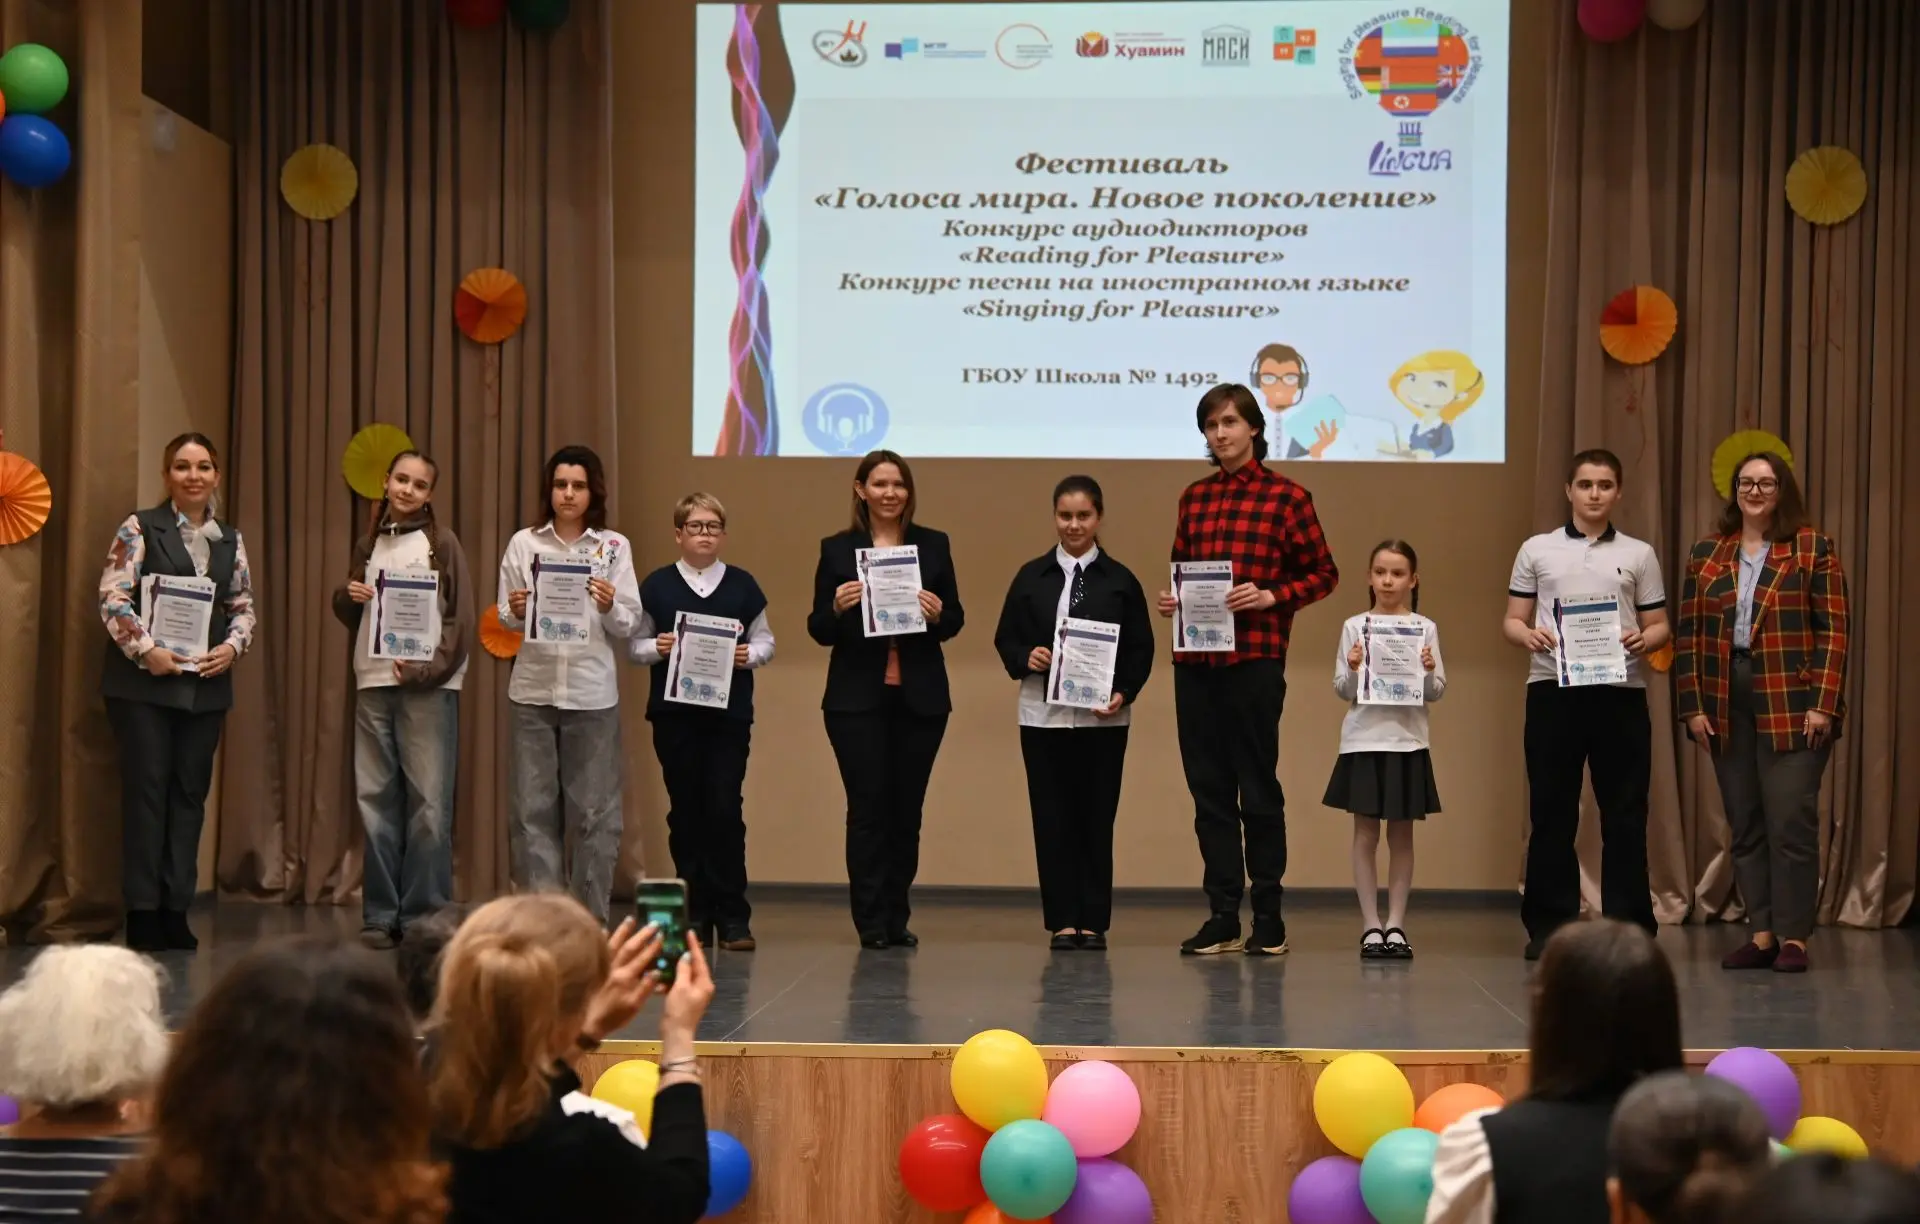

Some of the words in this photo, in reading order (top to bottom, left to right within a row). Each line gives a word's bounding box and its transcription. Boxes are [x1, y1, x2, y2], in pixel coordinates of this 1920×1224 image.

[1353, 9, 1410, 39] pleasure
[1414, 7, 1469, 36] Reading
[1114, 44, 1185, 60] Хуамин
[1202, 36, 1250, 60] МАСИ
[1015, 152, 1228, 175] Фестиваль
[814, 186, 961, 210] «Голоса
[968, 192, 1079, 215] мира.
[1087, 186, 1205, 209] Новое
[1213, 191, 1437, 209] поколение»
[942, 219, 1065, 242] Конкурс
[1071, 218, 1309, 242] аудиодикторов
[958, 245, 1090, 269] «Reading
[1090, 245, 1139, 269] for
[1145, 245, 1285, 265] Pleasure»
[838, 272, 961, 295] Конкурс
[968, 277, 1051, 291] песни
[1058, 278, 1094, 291] на
[1101, 277, 1311, 296] иностранном
[1316, 278, 1411, 292] языке
[962, 298, 1085, 322] «Singing
[1085, 298, 1135, 322] for
[1141, 299, 1280, 319] Pleasure»
[962, 367, 1029, 384] ГБОУ
[1035, 368, 1121, 385] Школа
[1127, 368, 1157, 385] №
[1164, 371, 1219, 388] 1492
